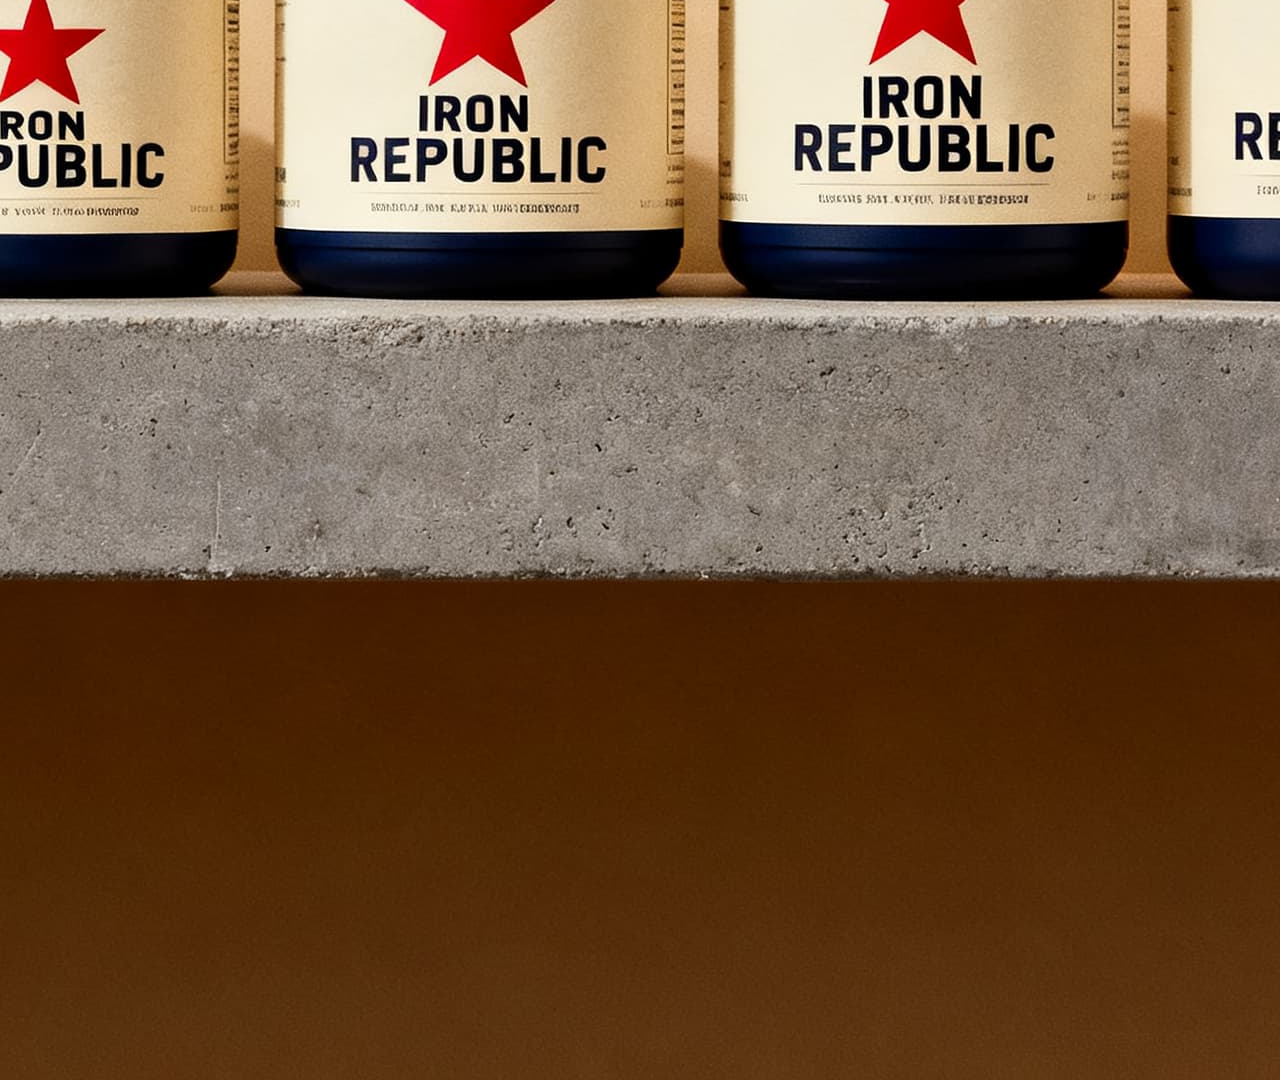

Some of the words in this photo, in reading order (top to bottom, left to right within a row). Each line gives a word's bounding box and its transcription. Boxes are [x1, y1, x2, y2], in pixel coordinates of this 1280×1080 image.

[418, 94, 529, 133] IRON
[862, 74, 982, 120] IRON
[350, 136, 607, 184] REPUBLIC
[794, 123, 1056, 174] REPUBLIC
